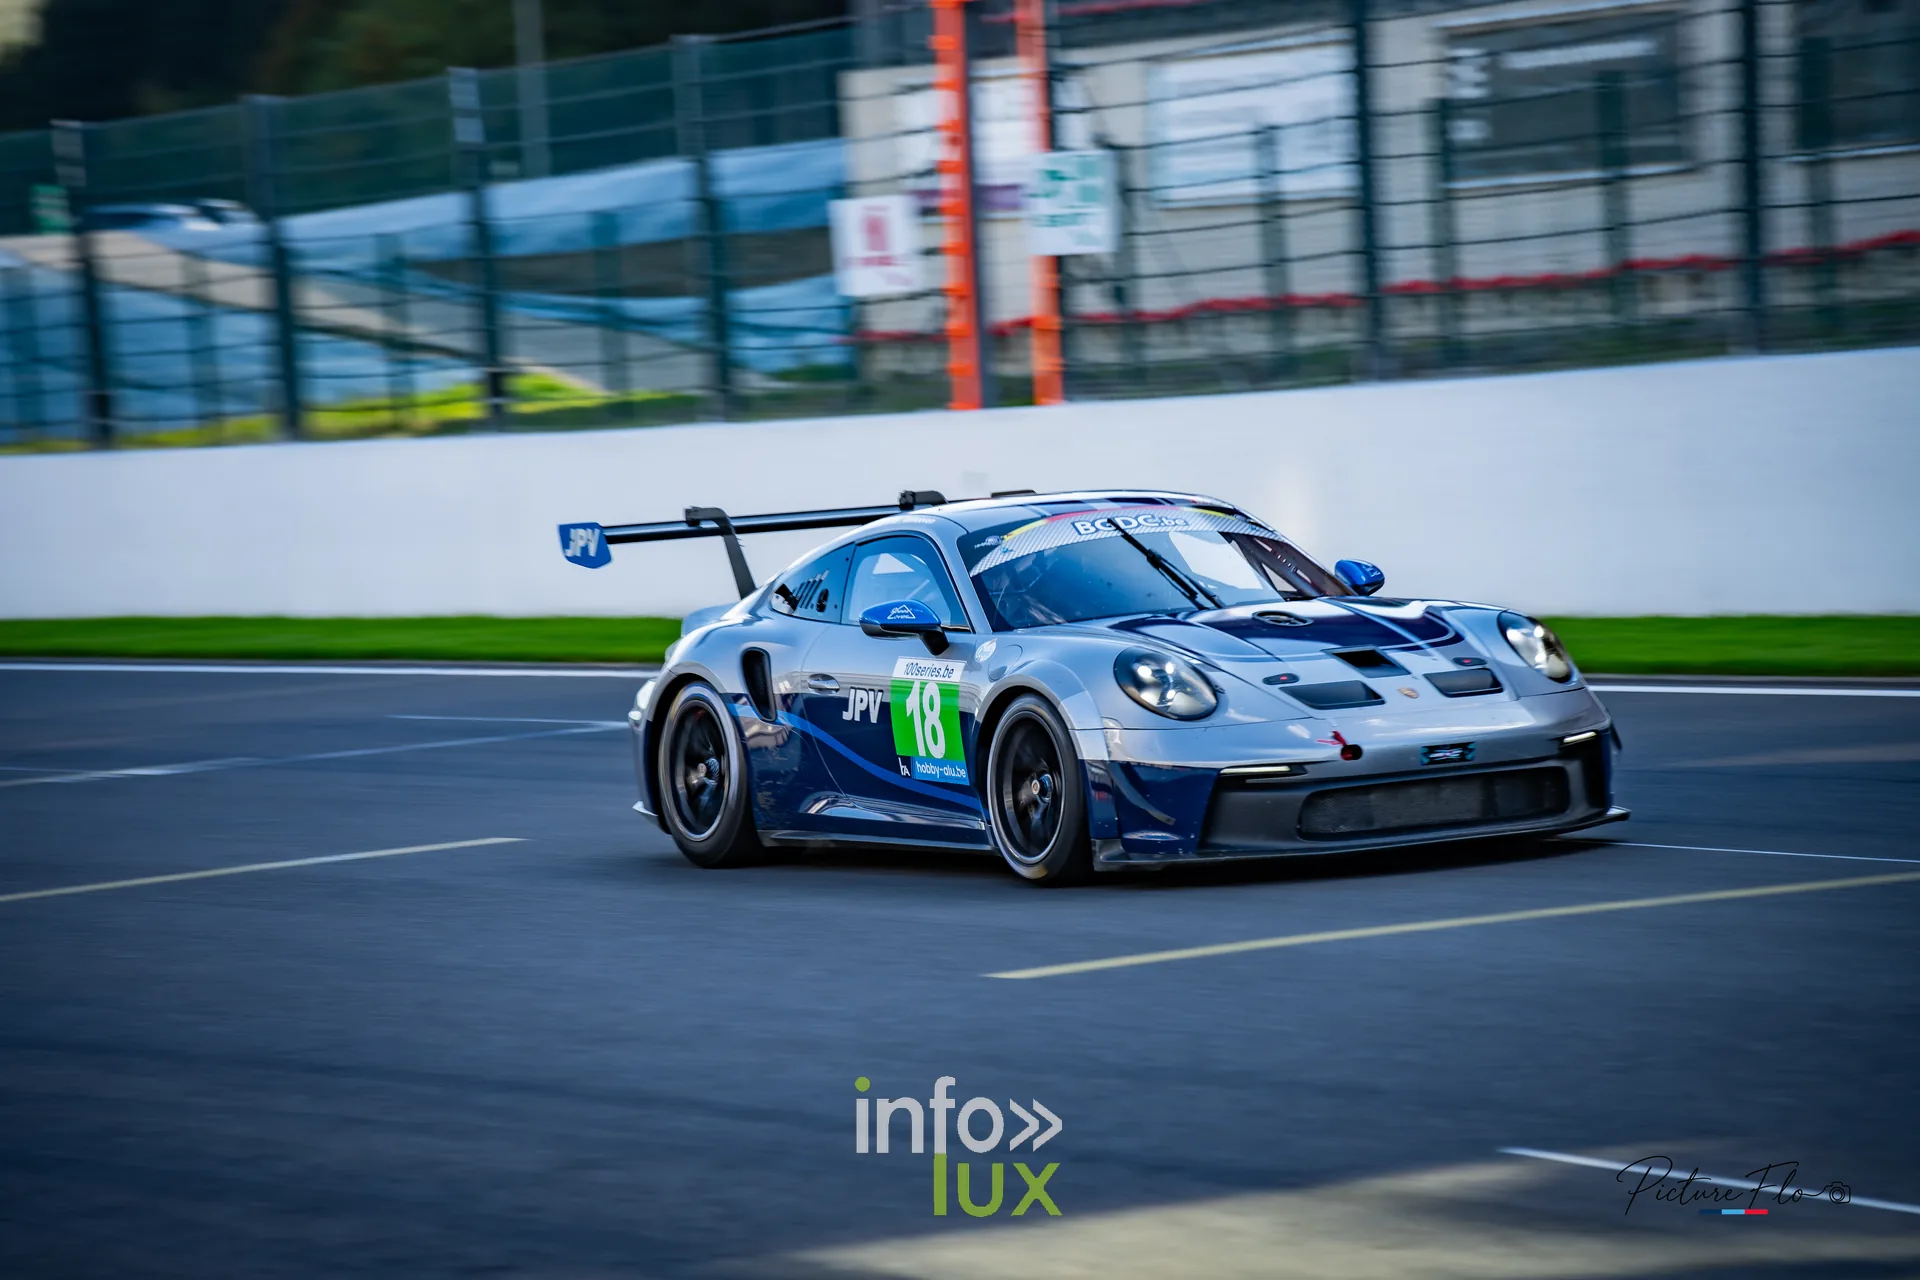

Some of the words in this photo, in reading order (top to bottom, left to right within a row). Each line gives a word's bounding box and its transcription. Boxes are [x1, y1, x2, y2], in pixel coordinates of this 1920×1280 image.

[1074, 513, 1187, 536] BGDC.be
[564, 527, 600, 557] JPV
[903, 661, 954, 679] 100series.be
[842, 687, 883, 724] JPV
[905, 681, 946, 759] 18
[915, 761, 967, 779] hobby-alu.be
